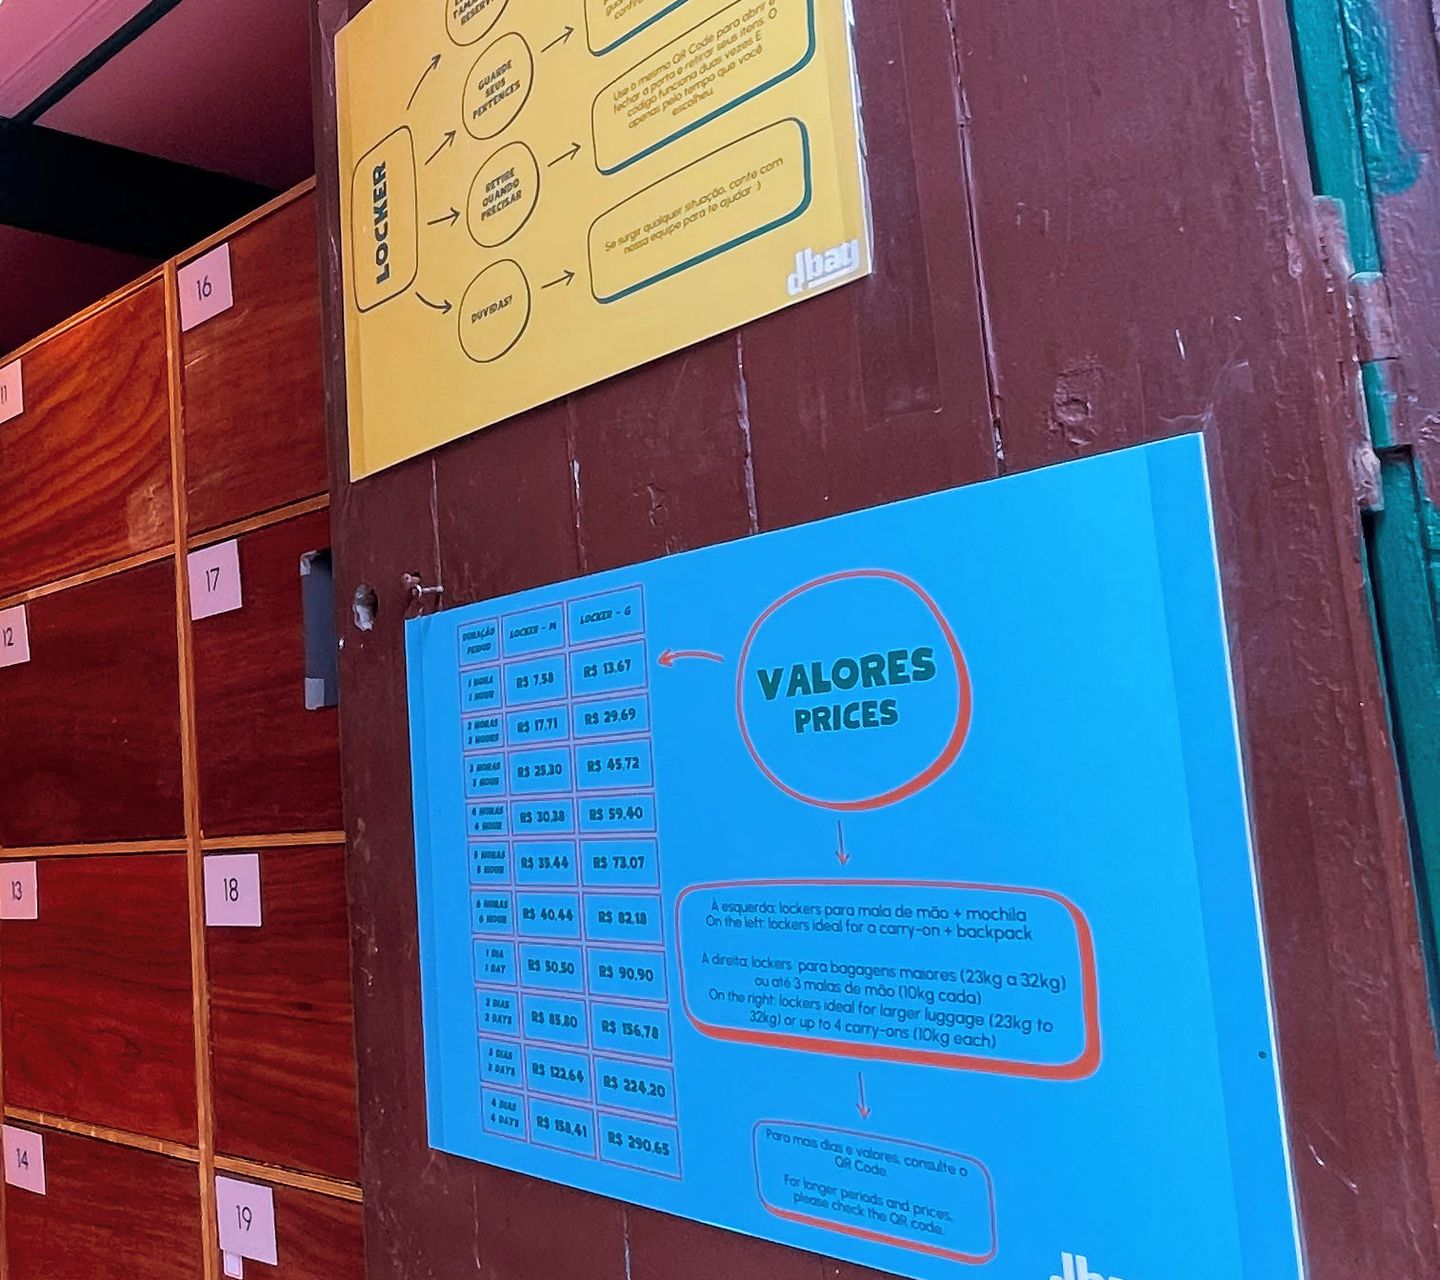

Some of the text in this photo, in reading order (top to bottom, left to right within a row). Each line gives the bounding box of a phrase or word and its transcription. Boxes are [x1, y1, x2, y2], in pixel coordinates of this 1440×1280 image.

[479, 60, 511, 90] GUARDE
[473, 80, 520, 119] PERTENCES
[485, 77, 505, 98] SEUS
[729, 171, 758, 190] conte
[760, 157, 783, 174] com
[482, 178, 520, 207] QUANDO
[481, 190, 521, 221] PRECISAR
[373, 161, 390, 284] LOCKER
[650, 221, 681, 240] equipe
[683, 210, 706, 228] para
[788, 239, 859, 295] dbag
[196, 275, 212, 301] 16
[0, 385, 7, 404] 11
[206, 567, 220, 592] 17
[3, 627, 14, 647] 12
[516, 676, 529, 688] R$
[583, 664, 598, 678] R$
[757, 647, 936, 700] VALORES
[517, 721, 530, 733] R$
[584, 712, 599, 725] R$
[794, 699, 898, 733] PRICES
[518, 766, 530, 778] R$
[587, 760, 602, 772] R$
[589, 808, 603, 820] R$
[593, 856, 607, 869] R$
[11, 881, 22, 901] 13
[223, 878, 239, 902] 18
[598, 911, 613, 924] R$
[780, 902, 822, 915] lockers
[825, 907, 854, 918] para
[860, 905, 892, 917] mala
[895, 905, 912, 918] de
[917, 906, 948, 919] mão
[954, 909, 962, 918] +
[966, 908, 1026, 921] mochila
[705, 915, 722, 927] On
[725, 916, 742, 928] the
[768, 917, 810, 931] lockers
[813, 919, 842, 932] ideal
[846, 920, 864, 933] for
[867, 924, 876, 933] a
[880, 925, 940, 939] carry-on
[944, 926, 952, 935] +
[957, 924, 1034, 942] backpack
[598, 965, 613, 979] R$
[752, 955, 792, 970] lockers
[799, 962, 828, 974] para
[831, 960, 896, 979] bagagens
[900, 966, 958, 981] maiores
[960, 969, 1002, 988] (23kg
[1007, 976, 1018, 986] a
[1021, 973, 1066, 992] 32kg)
[754, 977, 982, 1005] ou até 3 malas de mão (10kg cada)
[709, 988, 726, 1001] On
[728, 990, 744, 1003] the
[779, 995, 820, 1010] lockers
[824, 999, 854, 1013] ideal
[859, 1002, 876, 1016] for
[880, 1004, 920, 1022] larger
[925, 1008, 984, 1029] luggage
[990, 1014, 1032, 1035] (23kg
[1038, 1019, 1054, 1033] to
[601, 1020, 616, 1034] R$
[750, 1011, 996, 1049] 32kg) or up to 4 carry-ons (10kg each)
[603, 1075, 618, 1090] R$
[536, 1116, 550, 1130] R$
[607, 1131, 623, 1146] R$
[16, 1148, 29, 1170] 14
[766, 1129, 792, 1142] Para
[793, 1136, 818, 1148] mais
[820, 1139, 844, 1153] dias
[846, 1147, 854, 1155] e
[904, 1158, 956, 1175] consulte
[960, 1169, 968, 1177] o
[835, 1157, 852, 1169] QR
[784, 1175, 800, 1187] For
[804, 1179, 838, 1196] longer
[840, 1189, 884, 1205] periods
[887, 1199, 910, 1210] and
[236, 1205, 252, 1231] 19
[793, 1192, 830, 1208] please
[831, 1201, 864, 1216] check
[867, 1207, 888, 1222] the
[890, 1213, 908, 1226] QR
